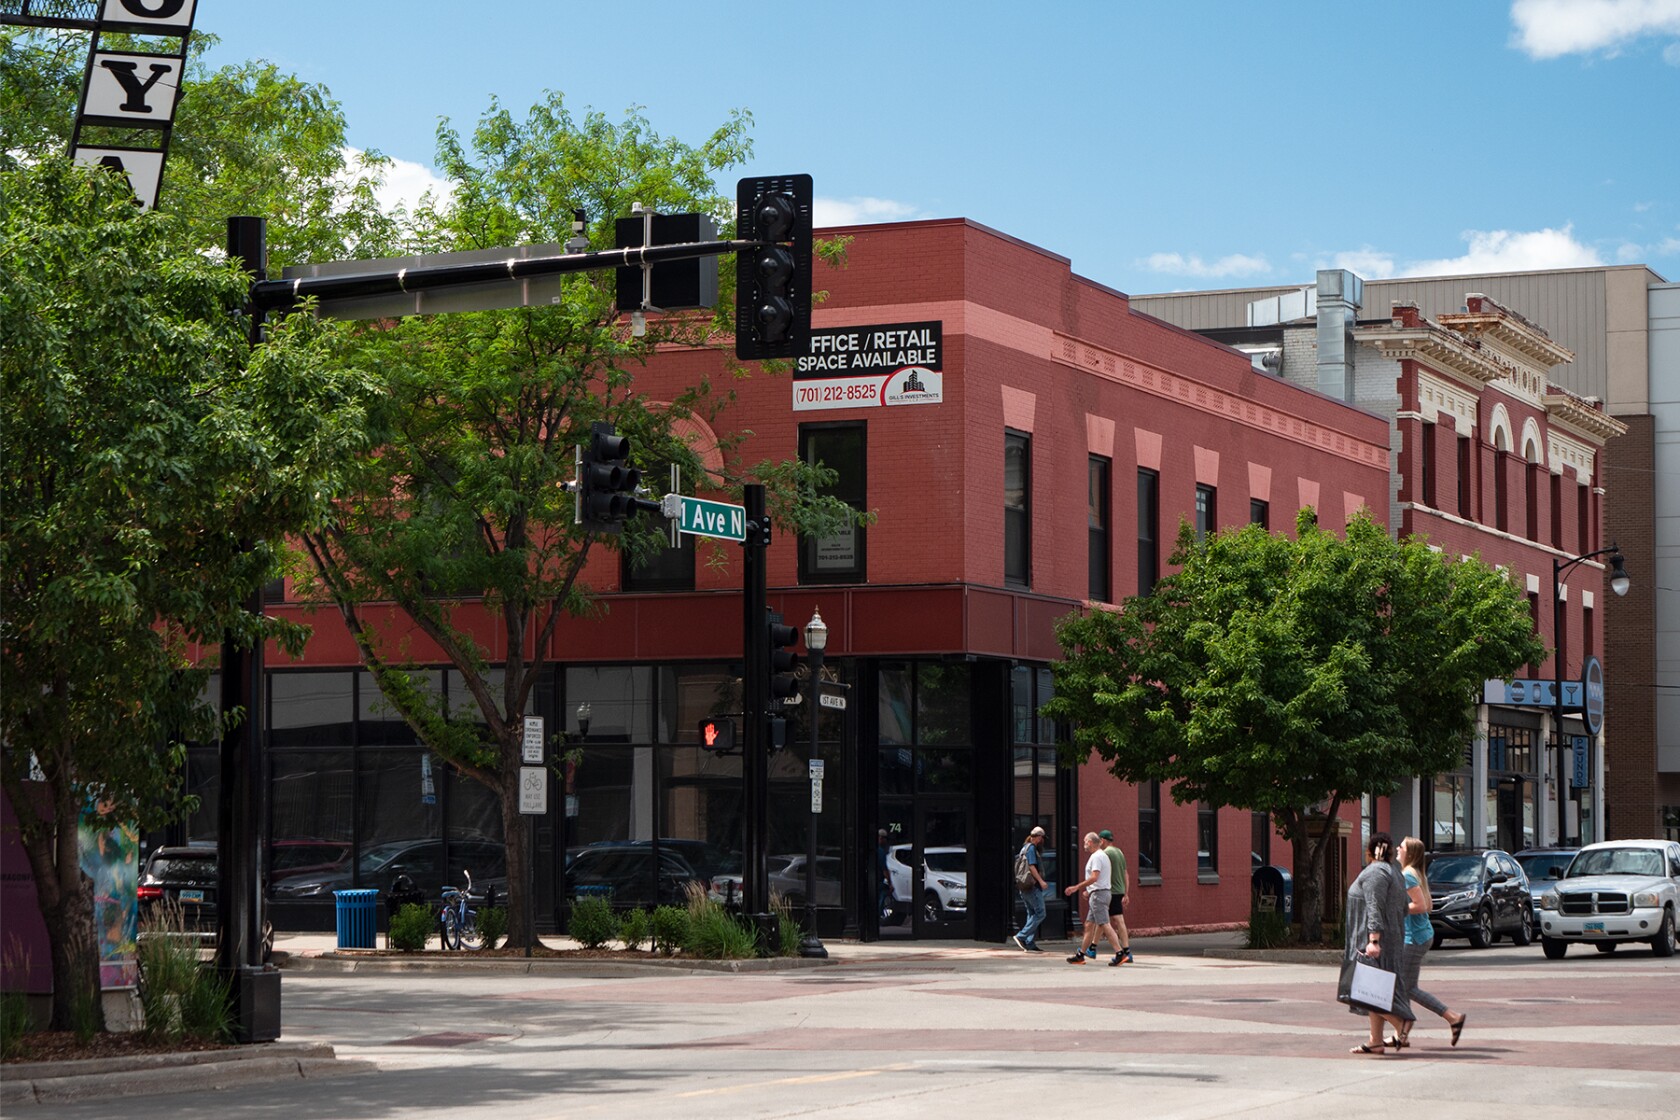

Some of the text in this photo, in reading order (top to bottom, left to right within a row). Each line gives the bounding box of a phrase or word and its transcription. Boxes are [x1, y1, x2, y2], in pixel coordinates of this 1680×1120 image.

[810, 334, 859, 353] FFICE
[873, 329, 936, 350] RETAIL
[798, 349, 936, 372] SPACE AVAILABLE
[796, 384, 876, 404] (701) 212-8525
[692, 504, 725, 533] Ave
[731, 510, 742, 536] N
[840, 699, 845, 707] N
[889, 823, 902, 833] 74
